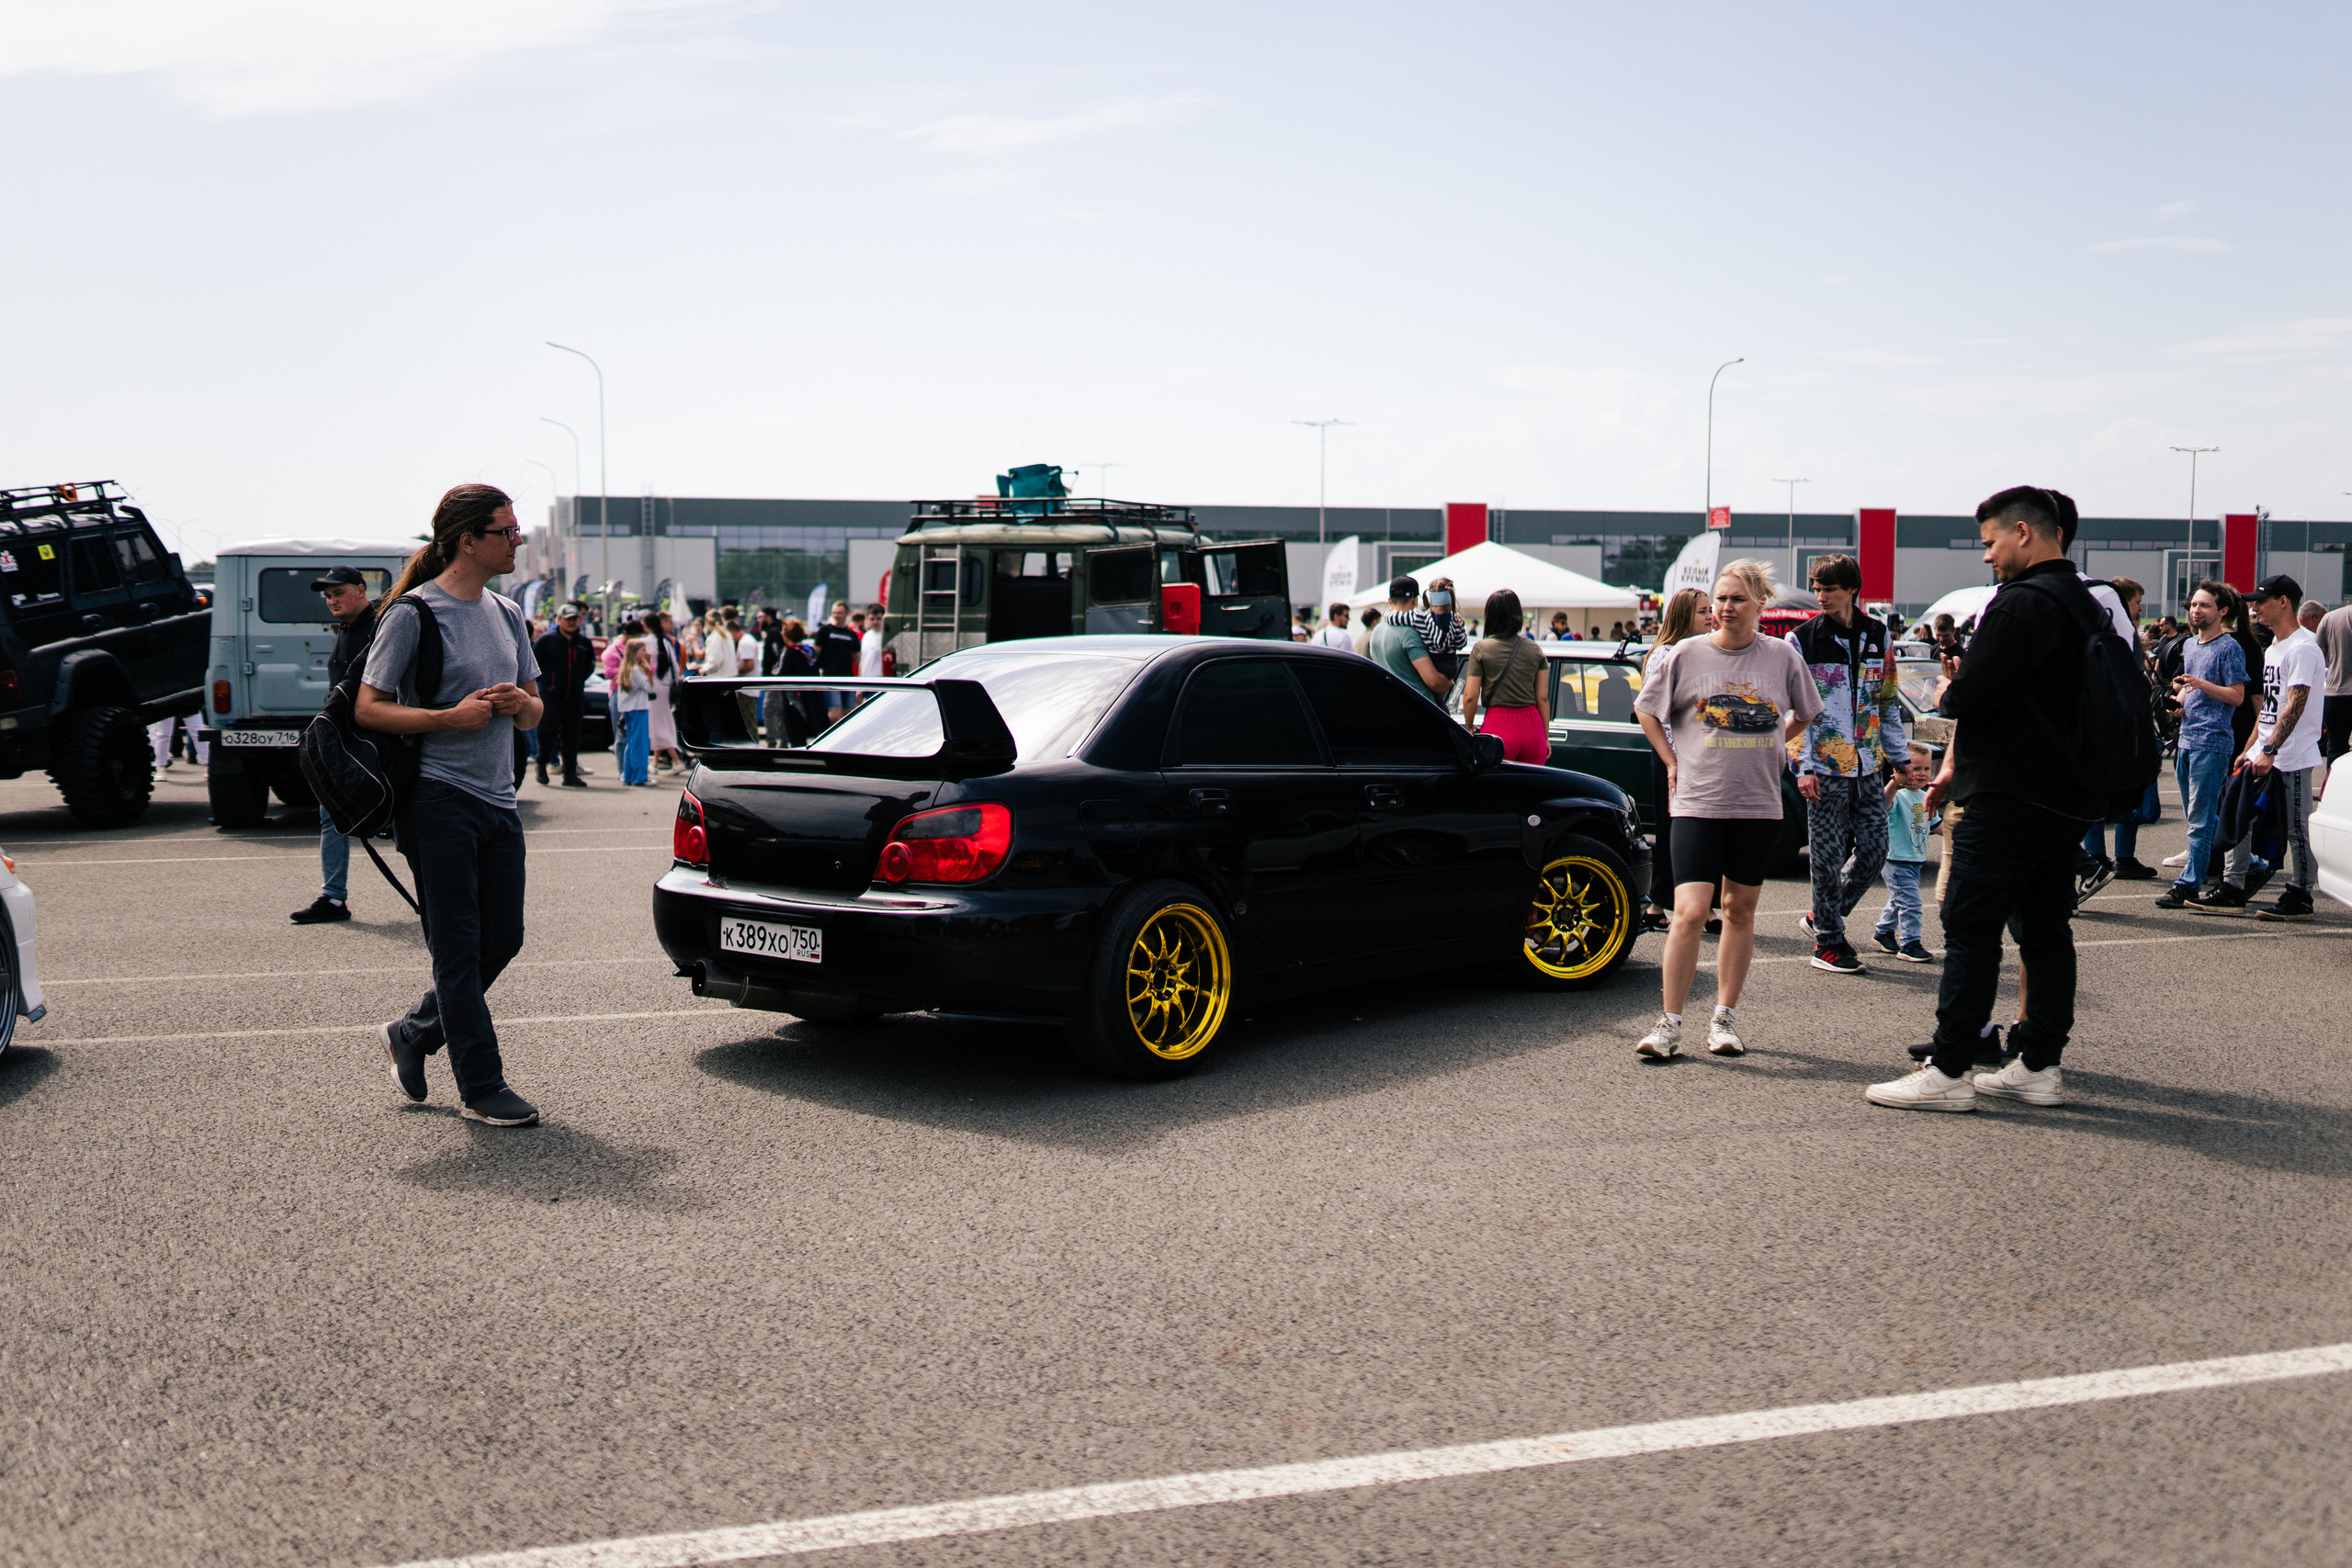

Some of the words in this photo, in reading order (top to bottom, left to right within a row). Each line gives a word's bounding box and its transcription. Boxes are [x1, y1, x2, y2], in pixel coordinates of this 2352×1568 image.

[726, 922, 788, 953] К389ХО
[792, 928, 817, 950] 750
[797, 949, 810, 958] RUS
